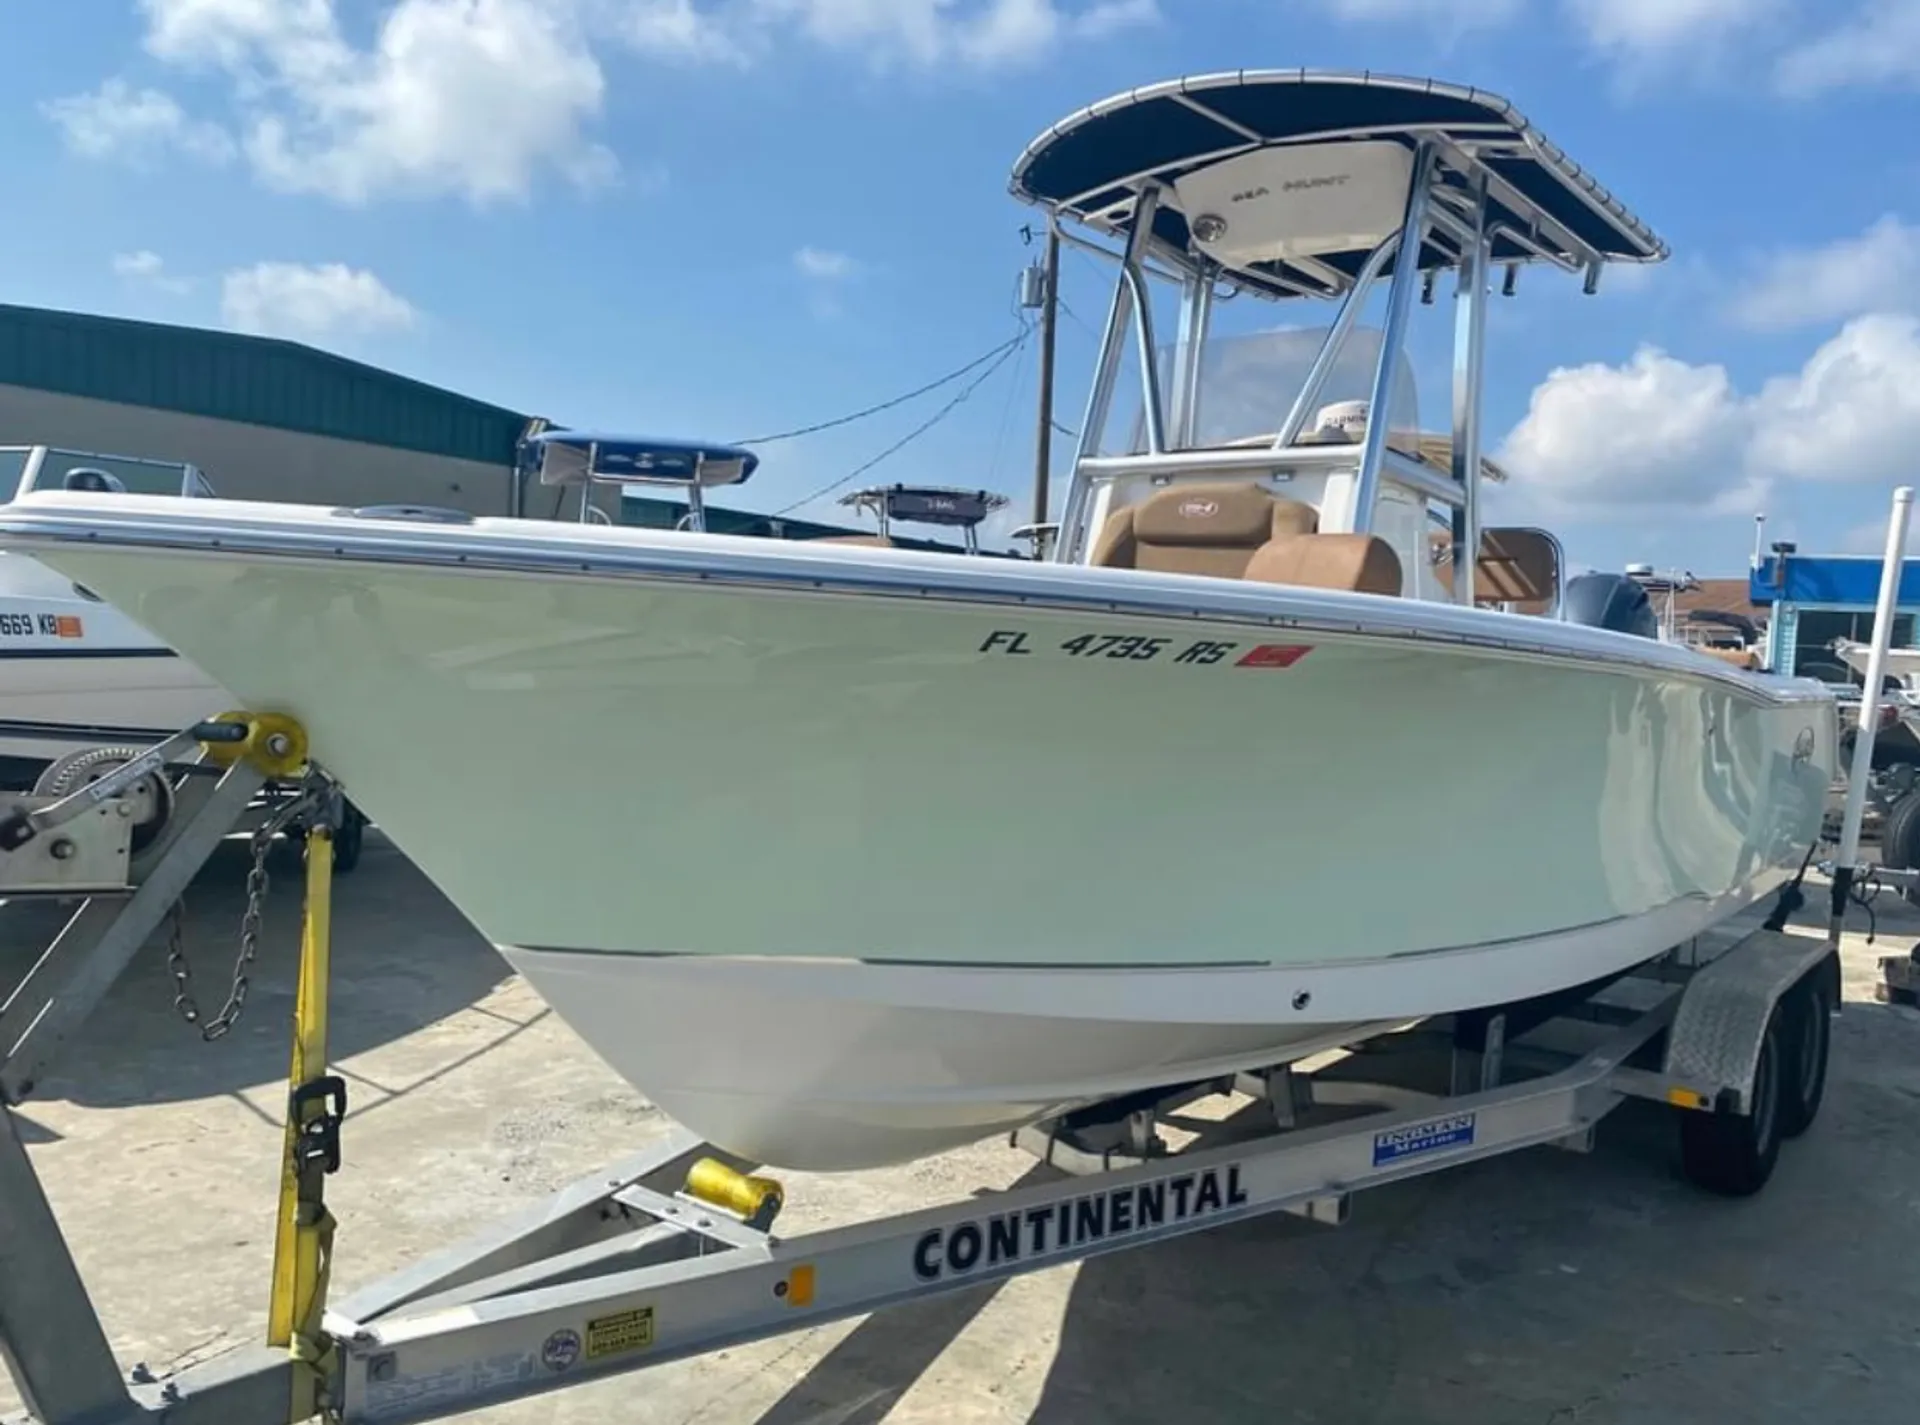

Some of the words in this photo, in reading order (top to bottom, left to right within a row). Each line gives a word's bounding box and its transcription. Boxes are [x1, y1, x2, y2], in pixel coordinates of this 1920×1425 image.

[978, 631, 1032, 655] FL
[1060, 634, 1173, 660] 4735
[1174, 641, 1238, 665] RS
[913, 1167, 1247, 1280] CONTINENTAL
